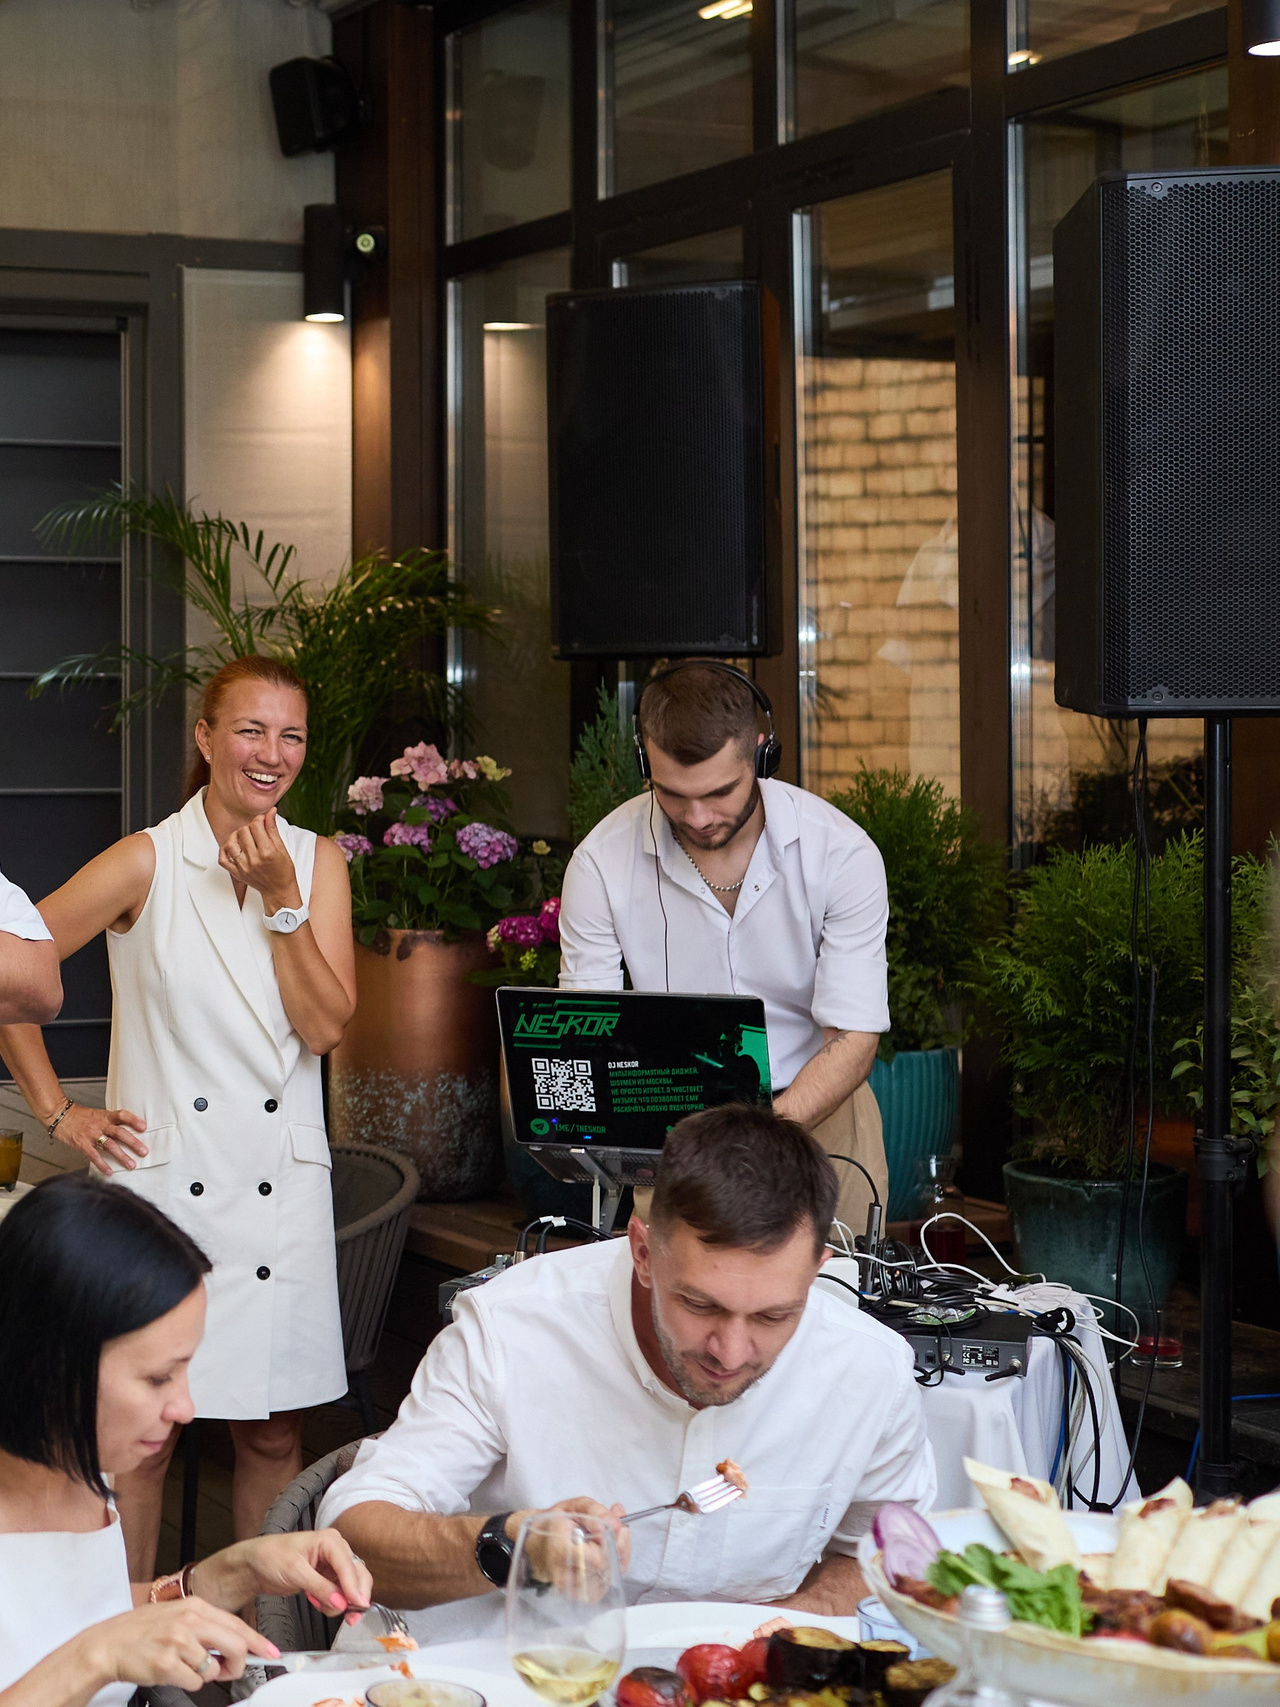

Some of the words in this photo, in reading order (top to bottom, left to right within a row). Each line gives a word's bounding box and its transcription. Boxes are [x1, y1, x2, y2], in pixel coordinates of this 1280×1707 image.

[513, 1011, 620, 1038] NESKOR
[609, 1068, 670, 1077] МУЛЬТИФОРМАТНЫЙ
[671, 1085, 703, 1093] ЧУВСТВУЕТ
[651, 1095, 684, 1103] ПОЗВОЛЯЕТ
[613, 1105, 645, 1113] РАСКАЧАТЬ
